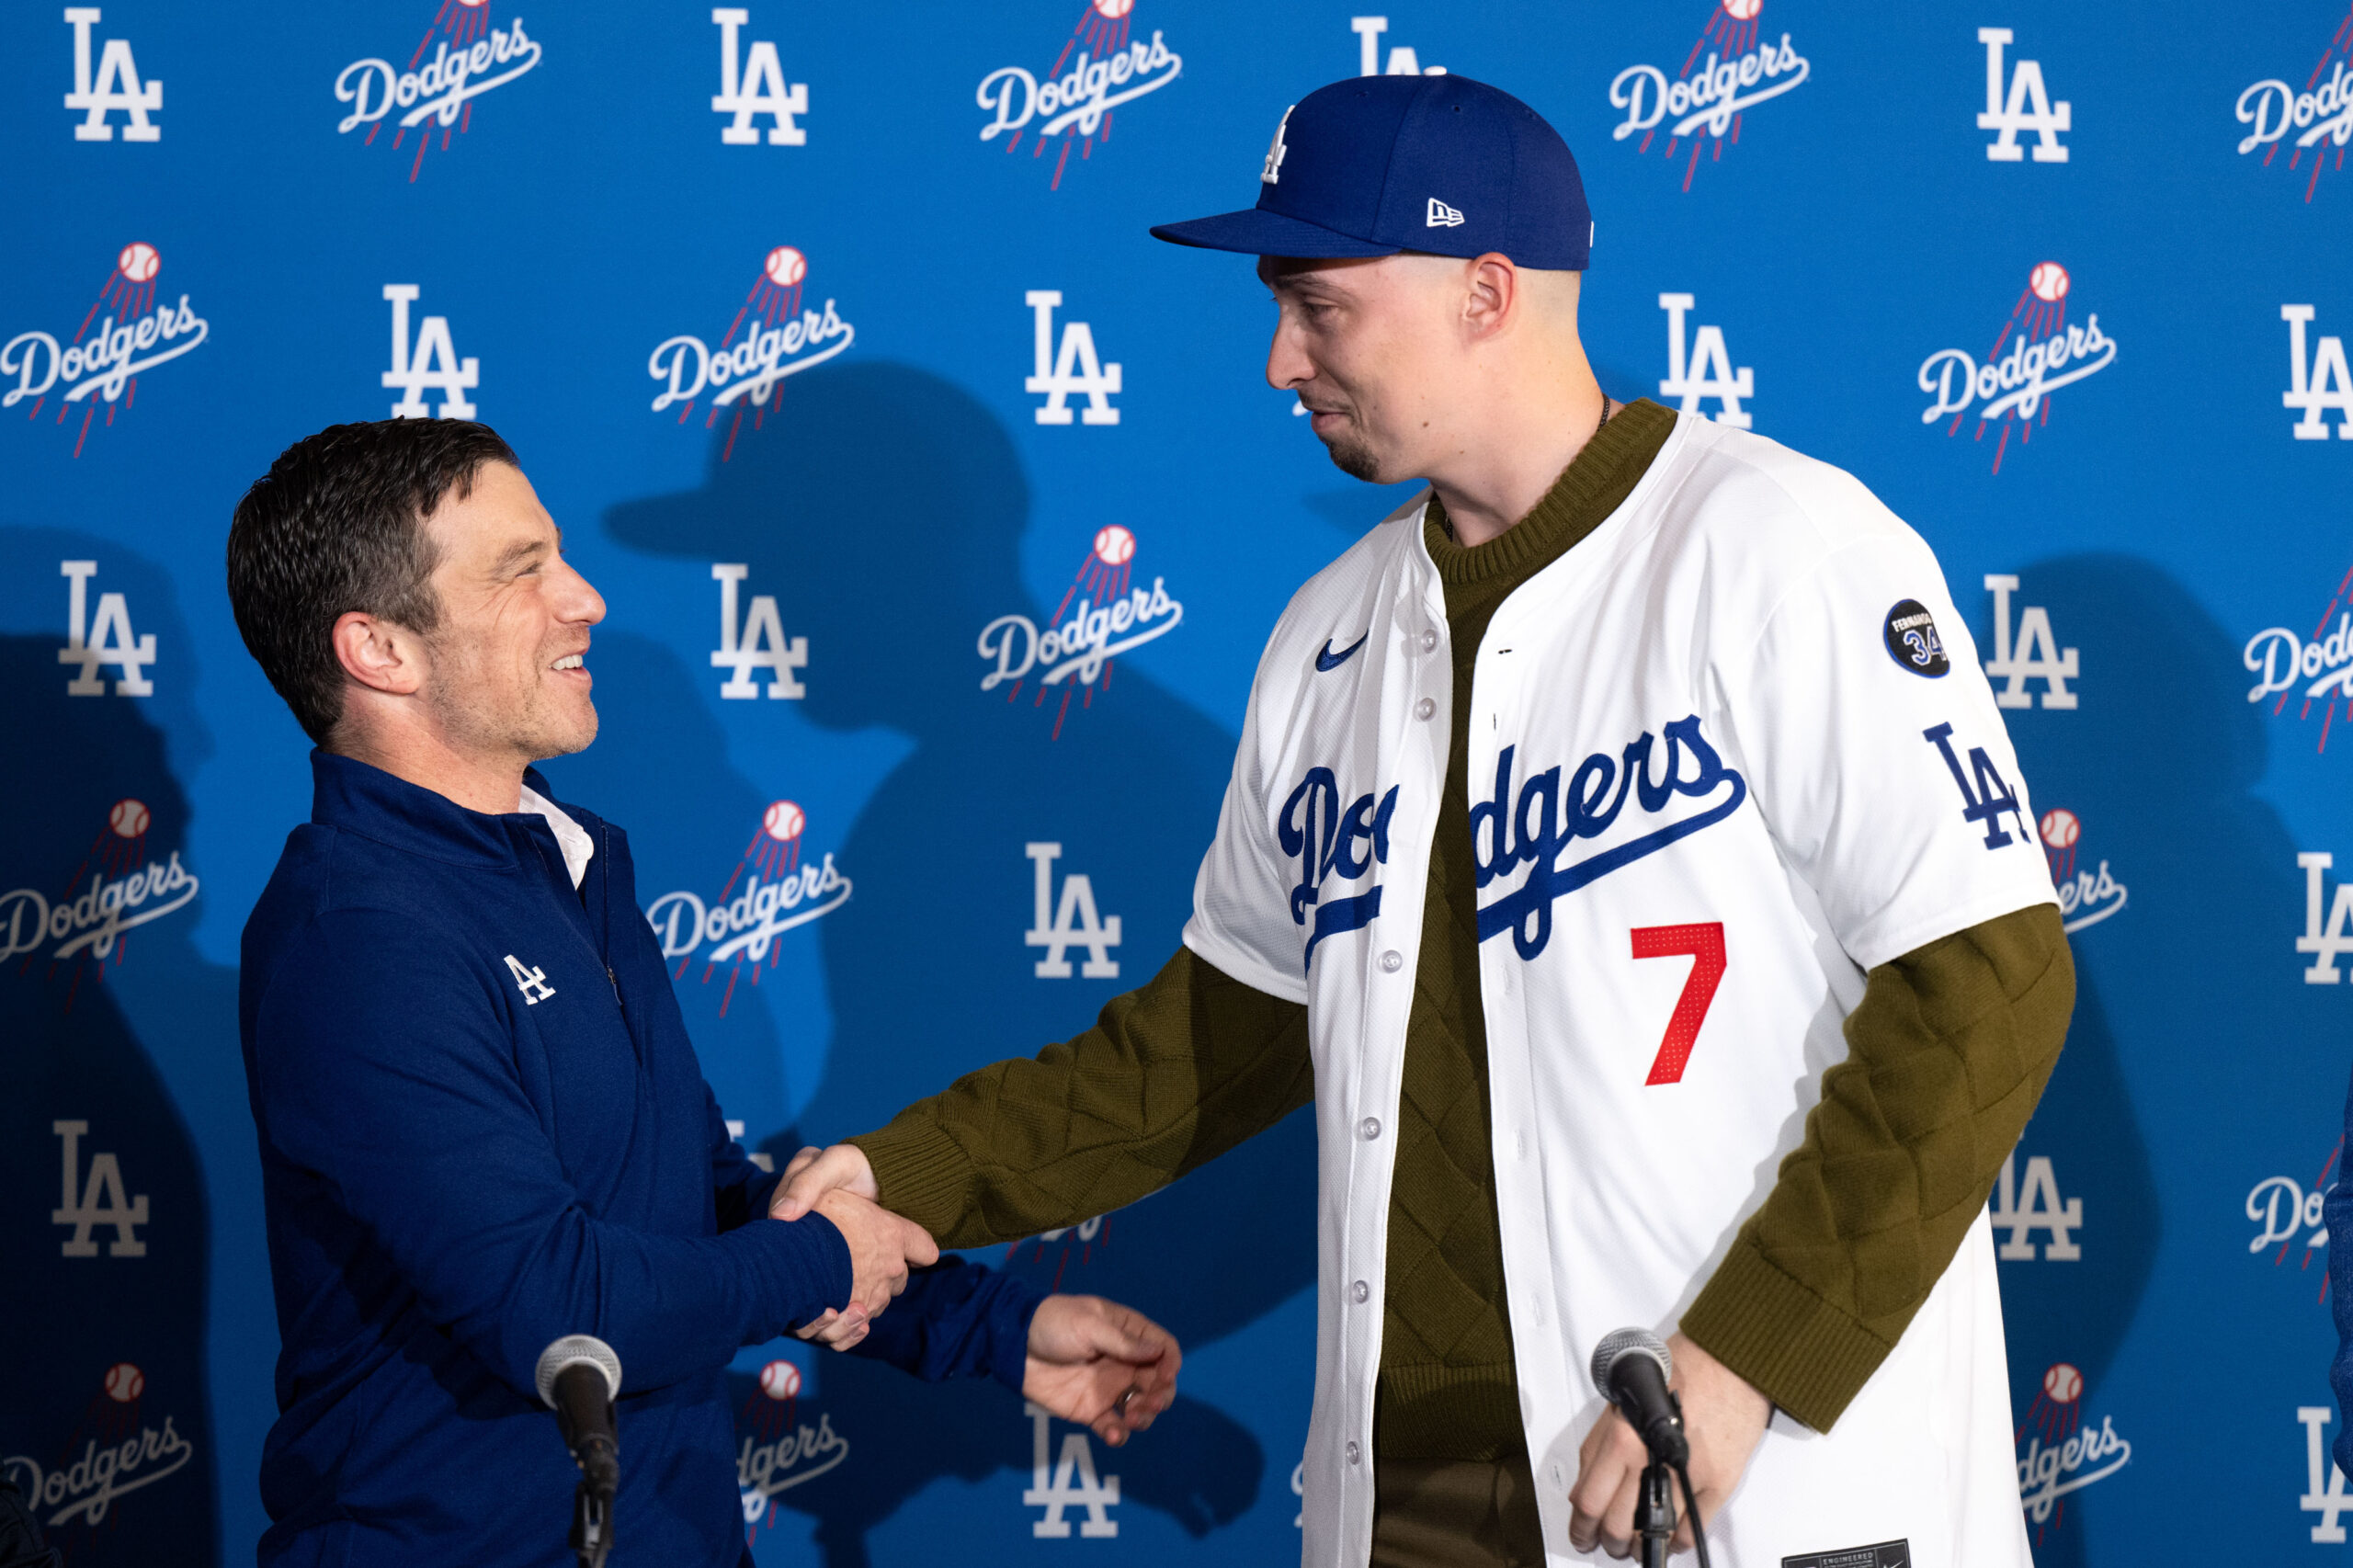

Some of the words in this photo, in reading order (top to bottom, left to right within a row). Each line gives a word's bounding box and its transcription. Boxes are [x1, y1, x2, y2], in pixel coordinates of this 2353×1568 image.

[64, 8, 163, 142] LA
[335, 18, 542, 133] Dodgers
[711, 8, 808, 145] LA
[977, 31, 1182, 141] Dodgers
[1610, 34, 1810, 140] Dodgers
[1977, 28, 2071, 162] LA
[2, 295, 209, 407] Dodgers
[382, 285, 479, 420] LA
[650, 299, 855, 412] Dodgers
[1026, 290, 1122, 425] LA
[1659, 293, 1754, 428] LA
[1918, 314, 2117, 423] Dodgers
[58, 560, 156, 696] LA
[710, 563, 808, 699] LA
[978, 577, 1183, 690] Dodgers
[1903, 626, 1948, 665] 34
[1984, 574, 2079, 710] LA
[1923, 722, 2031, 850] LA
[0, 851, 199, 962] Dodgers
[647, 853, 853, 961] Dodgers
[1025, 842, 1121, 978] LA
[1631, 922, 1728, 1086] 7
[51, 1119, 149, 1257] LA
[1022, 1403, 1120, 1538] LA
[2017, 1415, 2131, 1524] dgers
[1824, 1551, 1873, 1565] ENGINEERED
